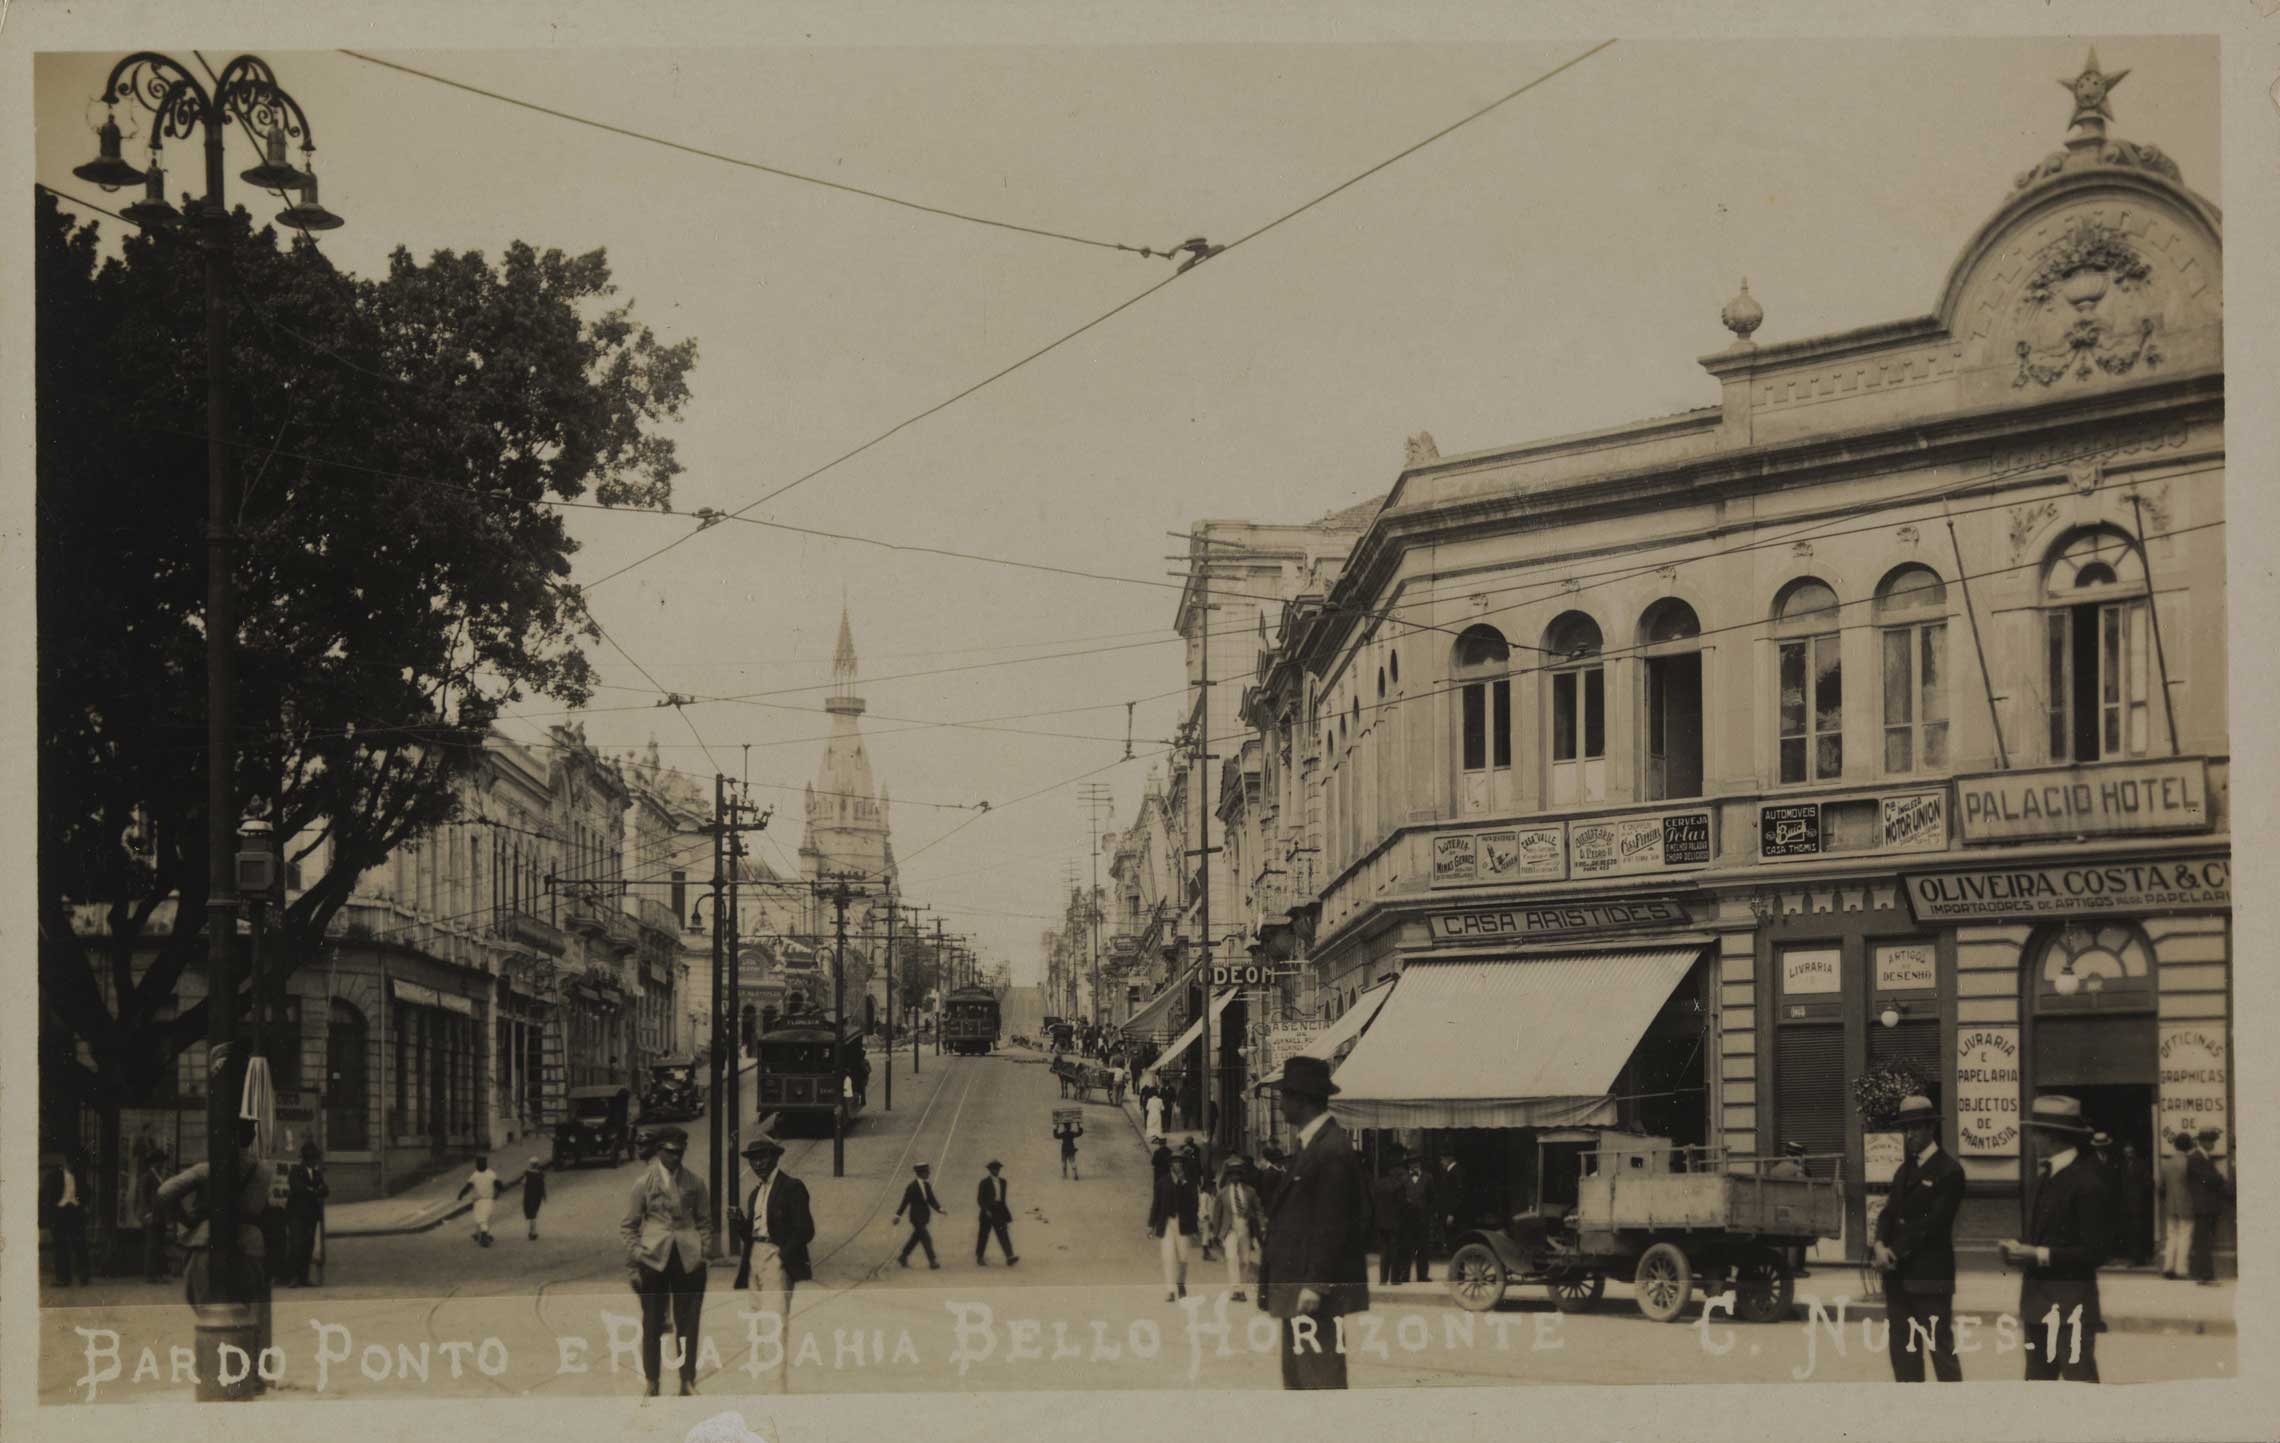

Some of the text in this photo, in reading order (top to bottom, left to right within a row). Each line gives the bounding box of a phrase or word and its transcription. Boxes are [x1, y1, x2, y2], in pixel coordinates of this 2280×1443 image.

[1966, 777, 2199, 822] PALACIO HOTEL
[1765, 807, 1816, 820] AUTOMOVEIS
[1885, 813, 1913, 846] MOTOR
[1912, 797, 1941, 831] UNION
[1665, 816, 1708, 828] CERVEJA
[1766, 846, 1786, 855] CASA
[2064, 865, 2171, 896] COSTA
[2175, 863, 2201, 890] &
[1930, 900, 2034, 914] IMPORTADORES
[2055, 897, 2115, 910] ARTIGOS
[1443, 903, 1672, 935] CASA ARISTIDES
[1789, 962, 1833, 978] LIVRARIA
[1883, 970, 1932, 982] DESENHO
[1959, 1033, 2016, 1057] LIVRARIA
[2160, 1031, 2225, 1059] OFFICINAS
[1958, 1069, 2019, 1084] PAPELARIA
[2160, 1069, 2225, 1085] GRAPHICAS
[1959, 1098, 2018, 1112] OBJECTOS
[2160, 1098, 2225, 1113] CARIMBOS
[1976, 1118, 1992, 1129] DE
[2182, 1118, 2197, 1129] DE
[1960, 1125, 2019, 1151] PHANTASIA
